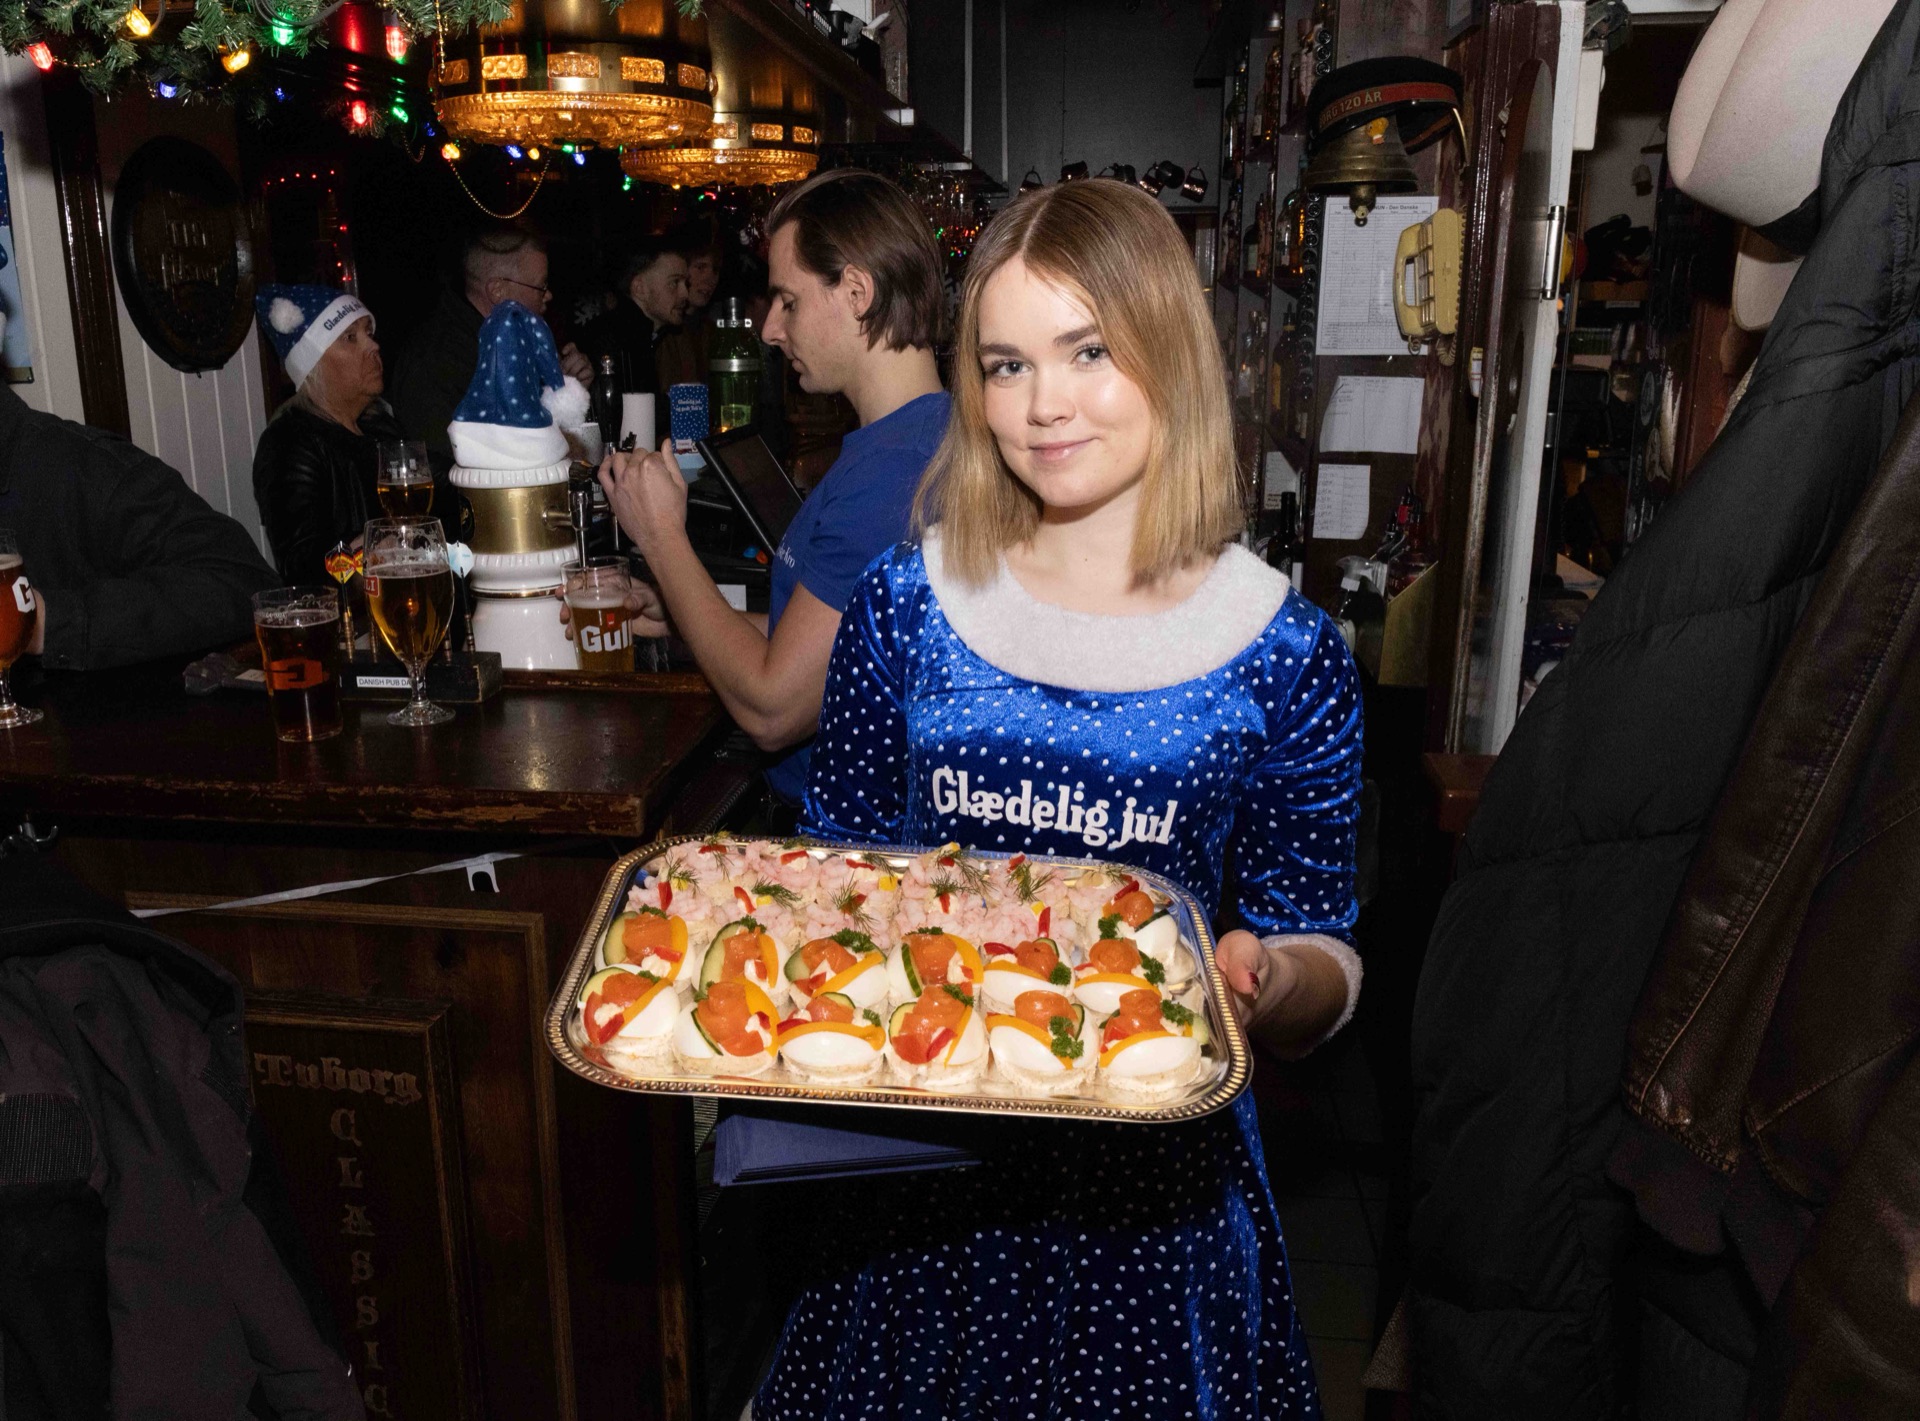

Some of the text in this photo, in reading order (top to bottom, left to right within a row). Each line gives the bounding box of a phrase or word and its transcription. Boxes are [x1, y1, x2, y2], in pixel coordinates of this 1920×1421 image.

[1340, 96, 1361, 113] 120
[323, 304, 356, 331] Glædelig
[358, 678, 385, 686] DANISH
[931, 764, 1178, 850] Glædelig jul
[253, 1052, 423, 1107] Tuborg
